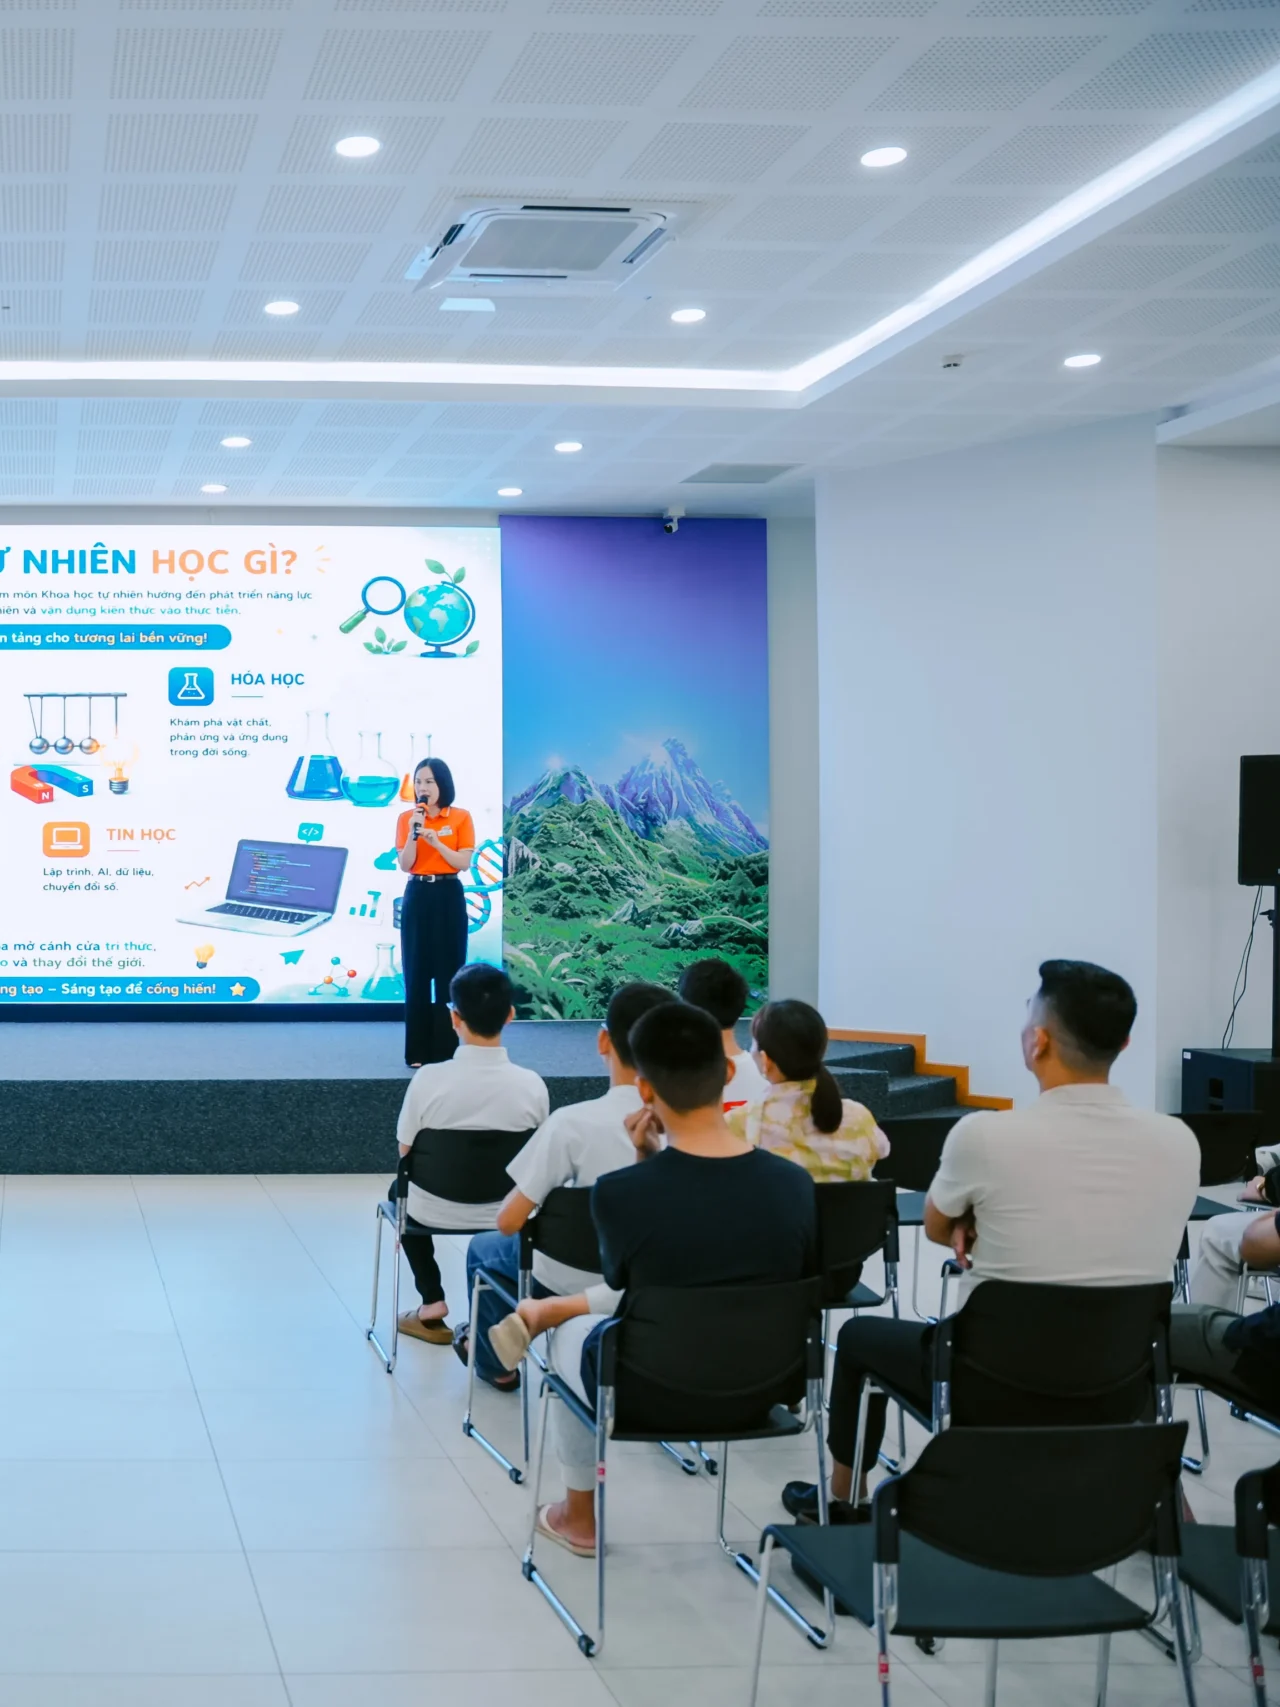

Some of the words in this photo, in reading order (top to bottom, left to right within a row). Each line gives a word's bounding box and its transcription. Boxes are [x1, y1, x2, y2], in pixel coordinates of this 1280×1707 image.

[23, 542, 136, 574] NHIÊN
[153, 549, 229, 581] HỌC
[244, 543, 297, 575] GÌ?
[12, 632, 42, 646] tảng
[45, 632, 70, 643] cho
[74, 633, 116, 646] tương
[119, 632, 136, 643] lai
[139, 631, 164, 643] bền
[169, 632, 208, 647] vững!
[231, 670, 265, 685] HÓA
[271, 673, 304, 688] HỌC
[41, 791, 50, 800] N
[81, 784, 89, 793] S
[106, 828, 134, 840] TIN
[141, 828, 176, 844] HỌC
[14, 941, 35, 950] mở
[40, 941, 71, 951] cánh
[76, 941, 100, 951] cửa
[124, 942, 156, 951] thức,
[13, 958, 27, 967] và
[33, 957, 61, 969] thay
[67, 955, 86, 967] đổi
[92, 957, 112, 967] thế
[118, 958, 144, 969] giới.
[21, 984, 44, 996] tạo
[62, 983, 96, 997] Sáng
[99, 984, 122, 996] tạo
[125, 981, 143, 994] để
[146, 982, 180, 997] cống
[183, 982, 216, 994] hiến!
